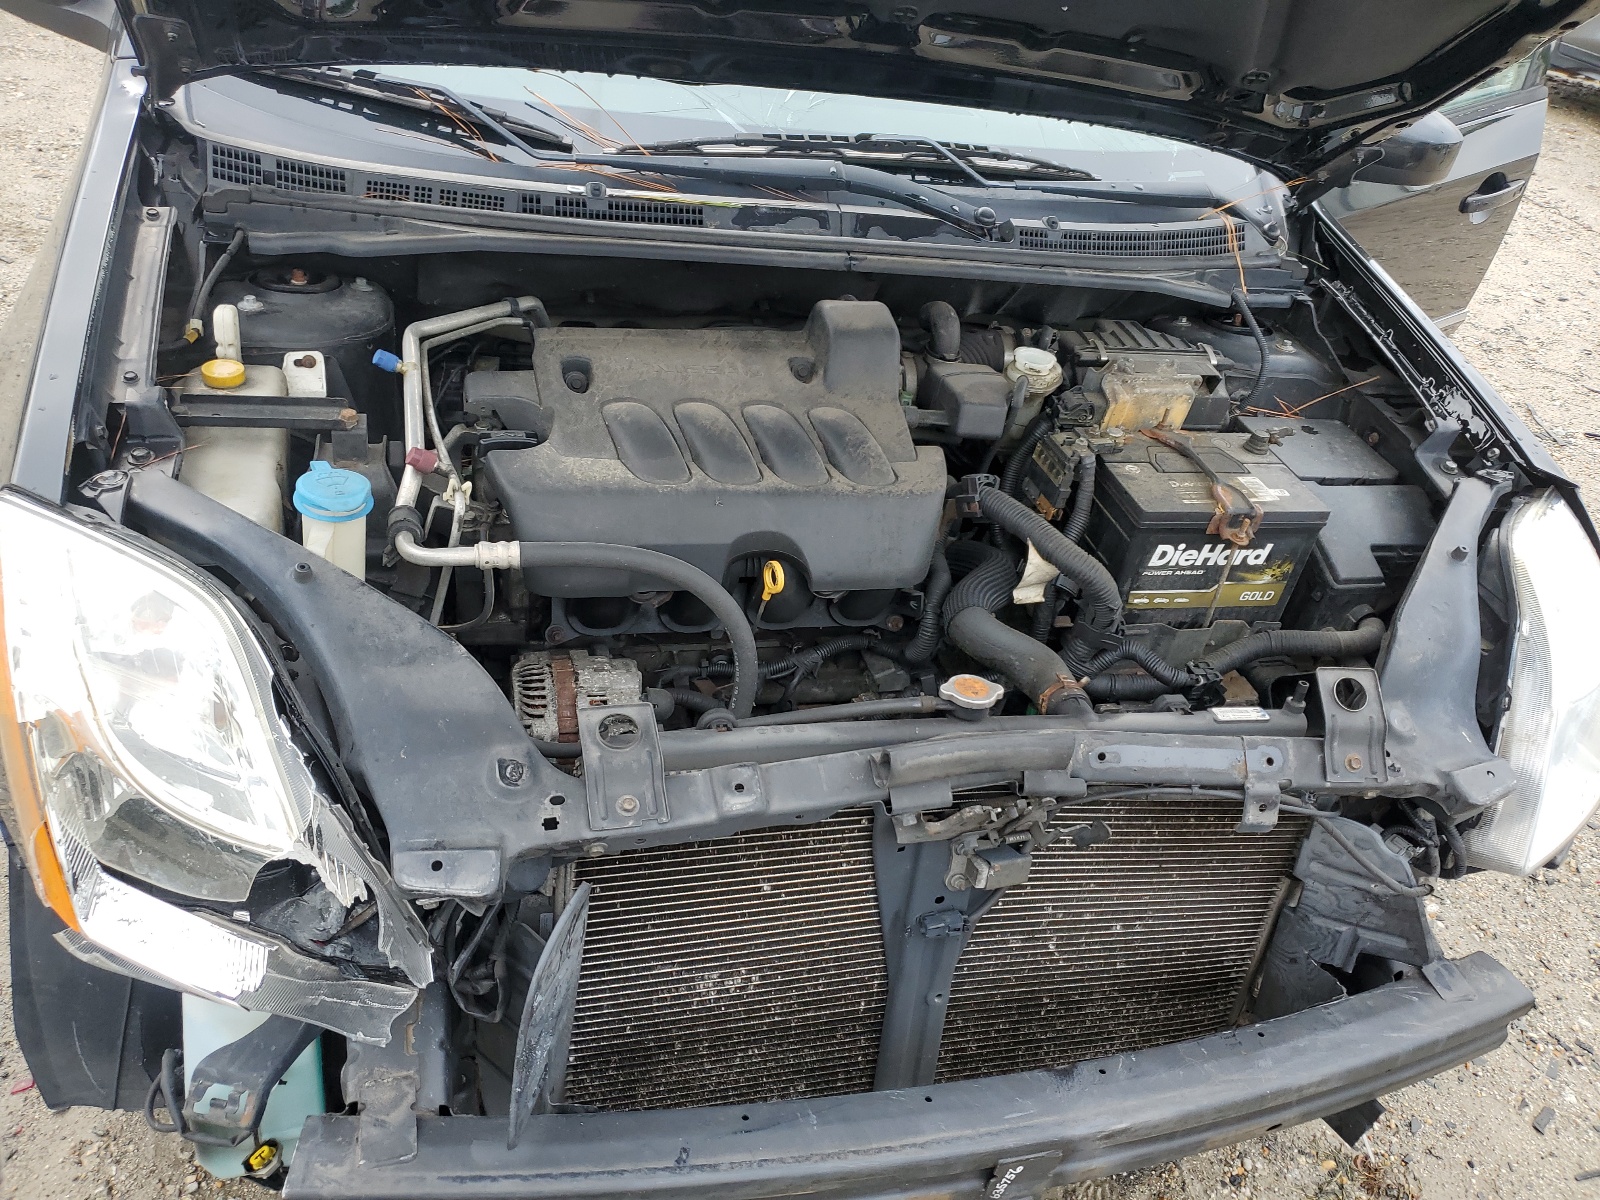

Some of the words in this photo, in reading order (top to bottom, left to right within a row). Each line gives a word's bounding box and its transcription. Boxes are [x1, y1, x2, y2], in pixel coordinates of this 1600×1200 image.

[1147, 543, 1275, 567] DieHard
[1239, 590, 1275, 601] GOLD
[990, 1165, 1025, 1199] 635756
